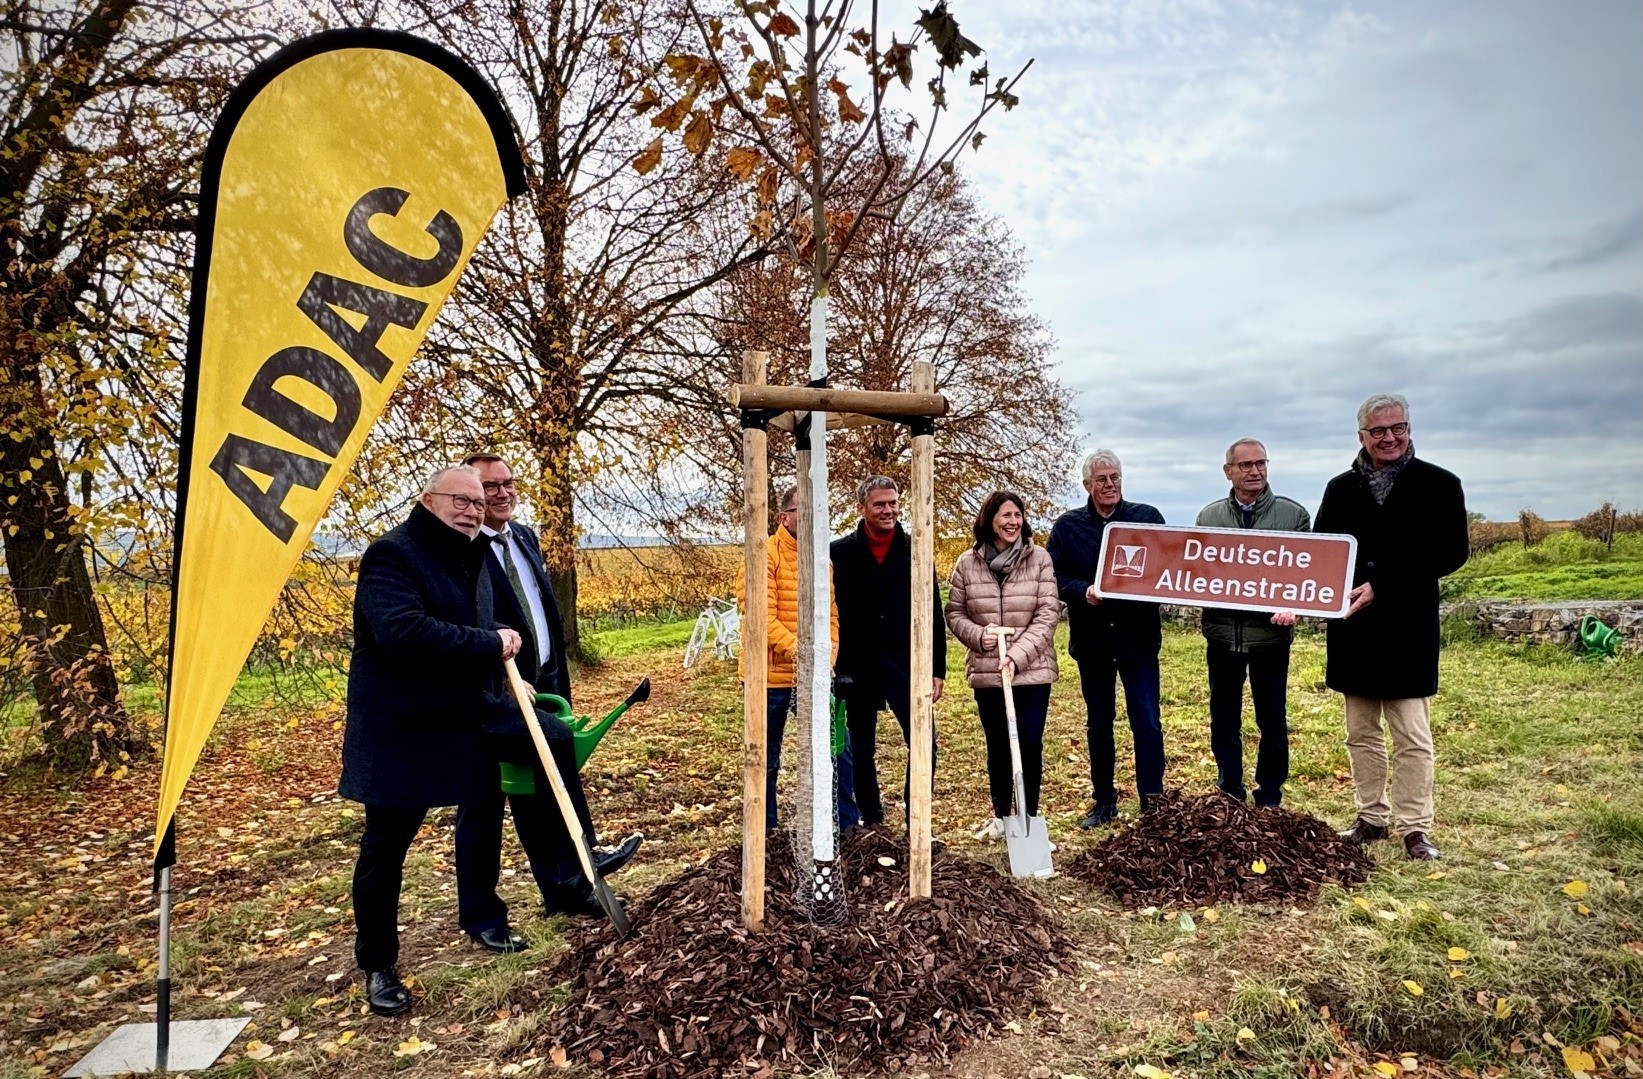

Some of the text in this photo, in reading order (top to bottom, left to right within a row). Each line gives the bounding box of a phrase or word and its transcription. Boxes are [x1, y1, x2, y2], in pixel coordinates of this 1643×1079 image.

[209, 187, 463, 544] ADAC
[1183, 539, 1312, 568] Deutsche
[1155, 568, 1335, 603] Alleenstraße
